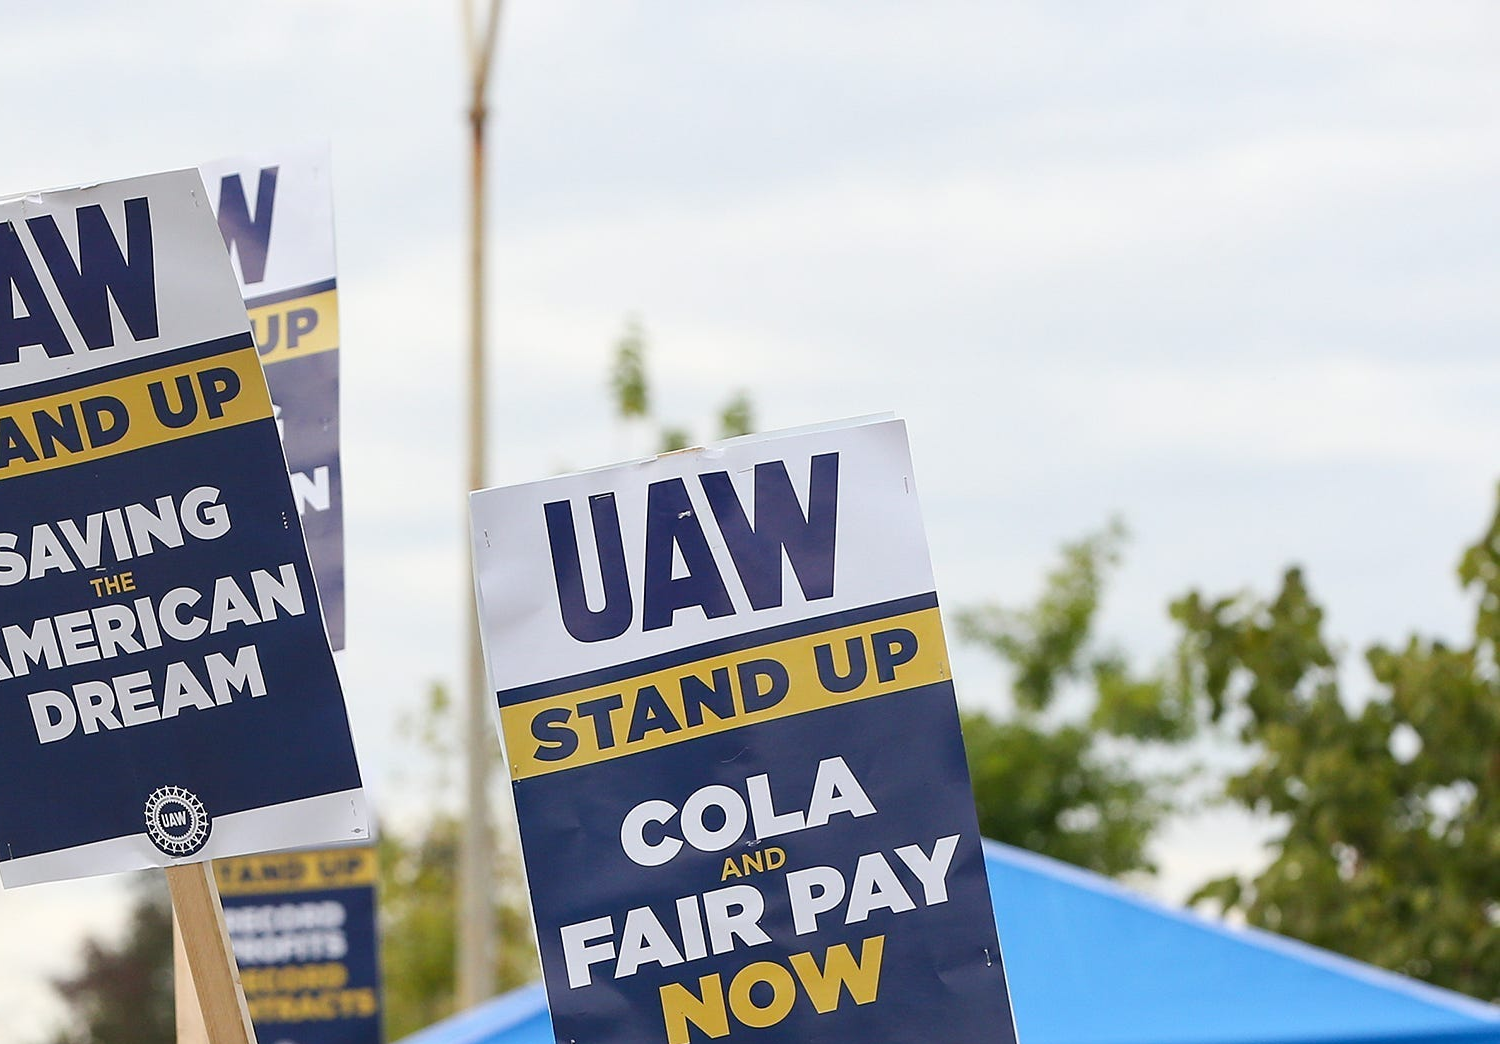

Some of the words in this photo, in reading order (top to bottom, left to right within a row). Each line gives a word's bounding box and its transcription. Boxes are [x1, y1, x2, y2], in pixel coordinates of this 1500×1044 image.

[147, 366, 243, 428] UP
[88, 570, 138, 599] THE
[542, 452, 840, 644] UAW
[26, 644, 269, 746] DREAM
[530, 657, 791, 763] STAND
[814, 626, 920, 694] UP
[161, 811, 186, 828] UAW
[619, 755, 878, 868] COLA
[220, 860, 306, 880] TAND
[719, 845, 788, 882] AND
[559, 883, 772, 991] FAIR
[783, 833, 962, 937] PAY
